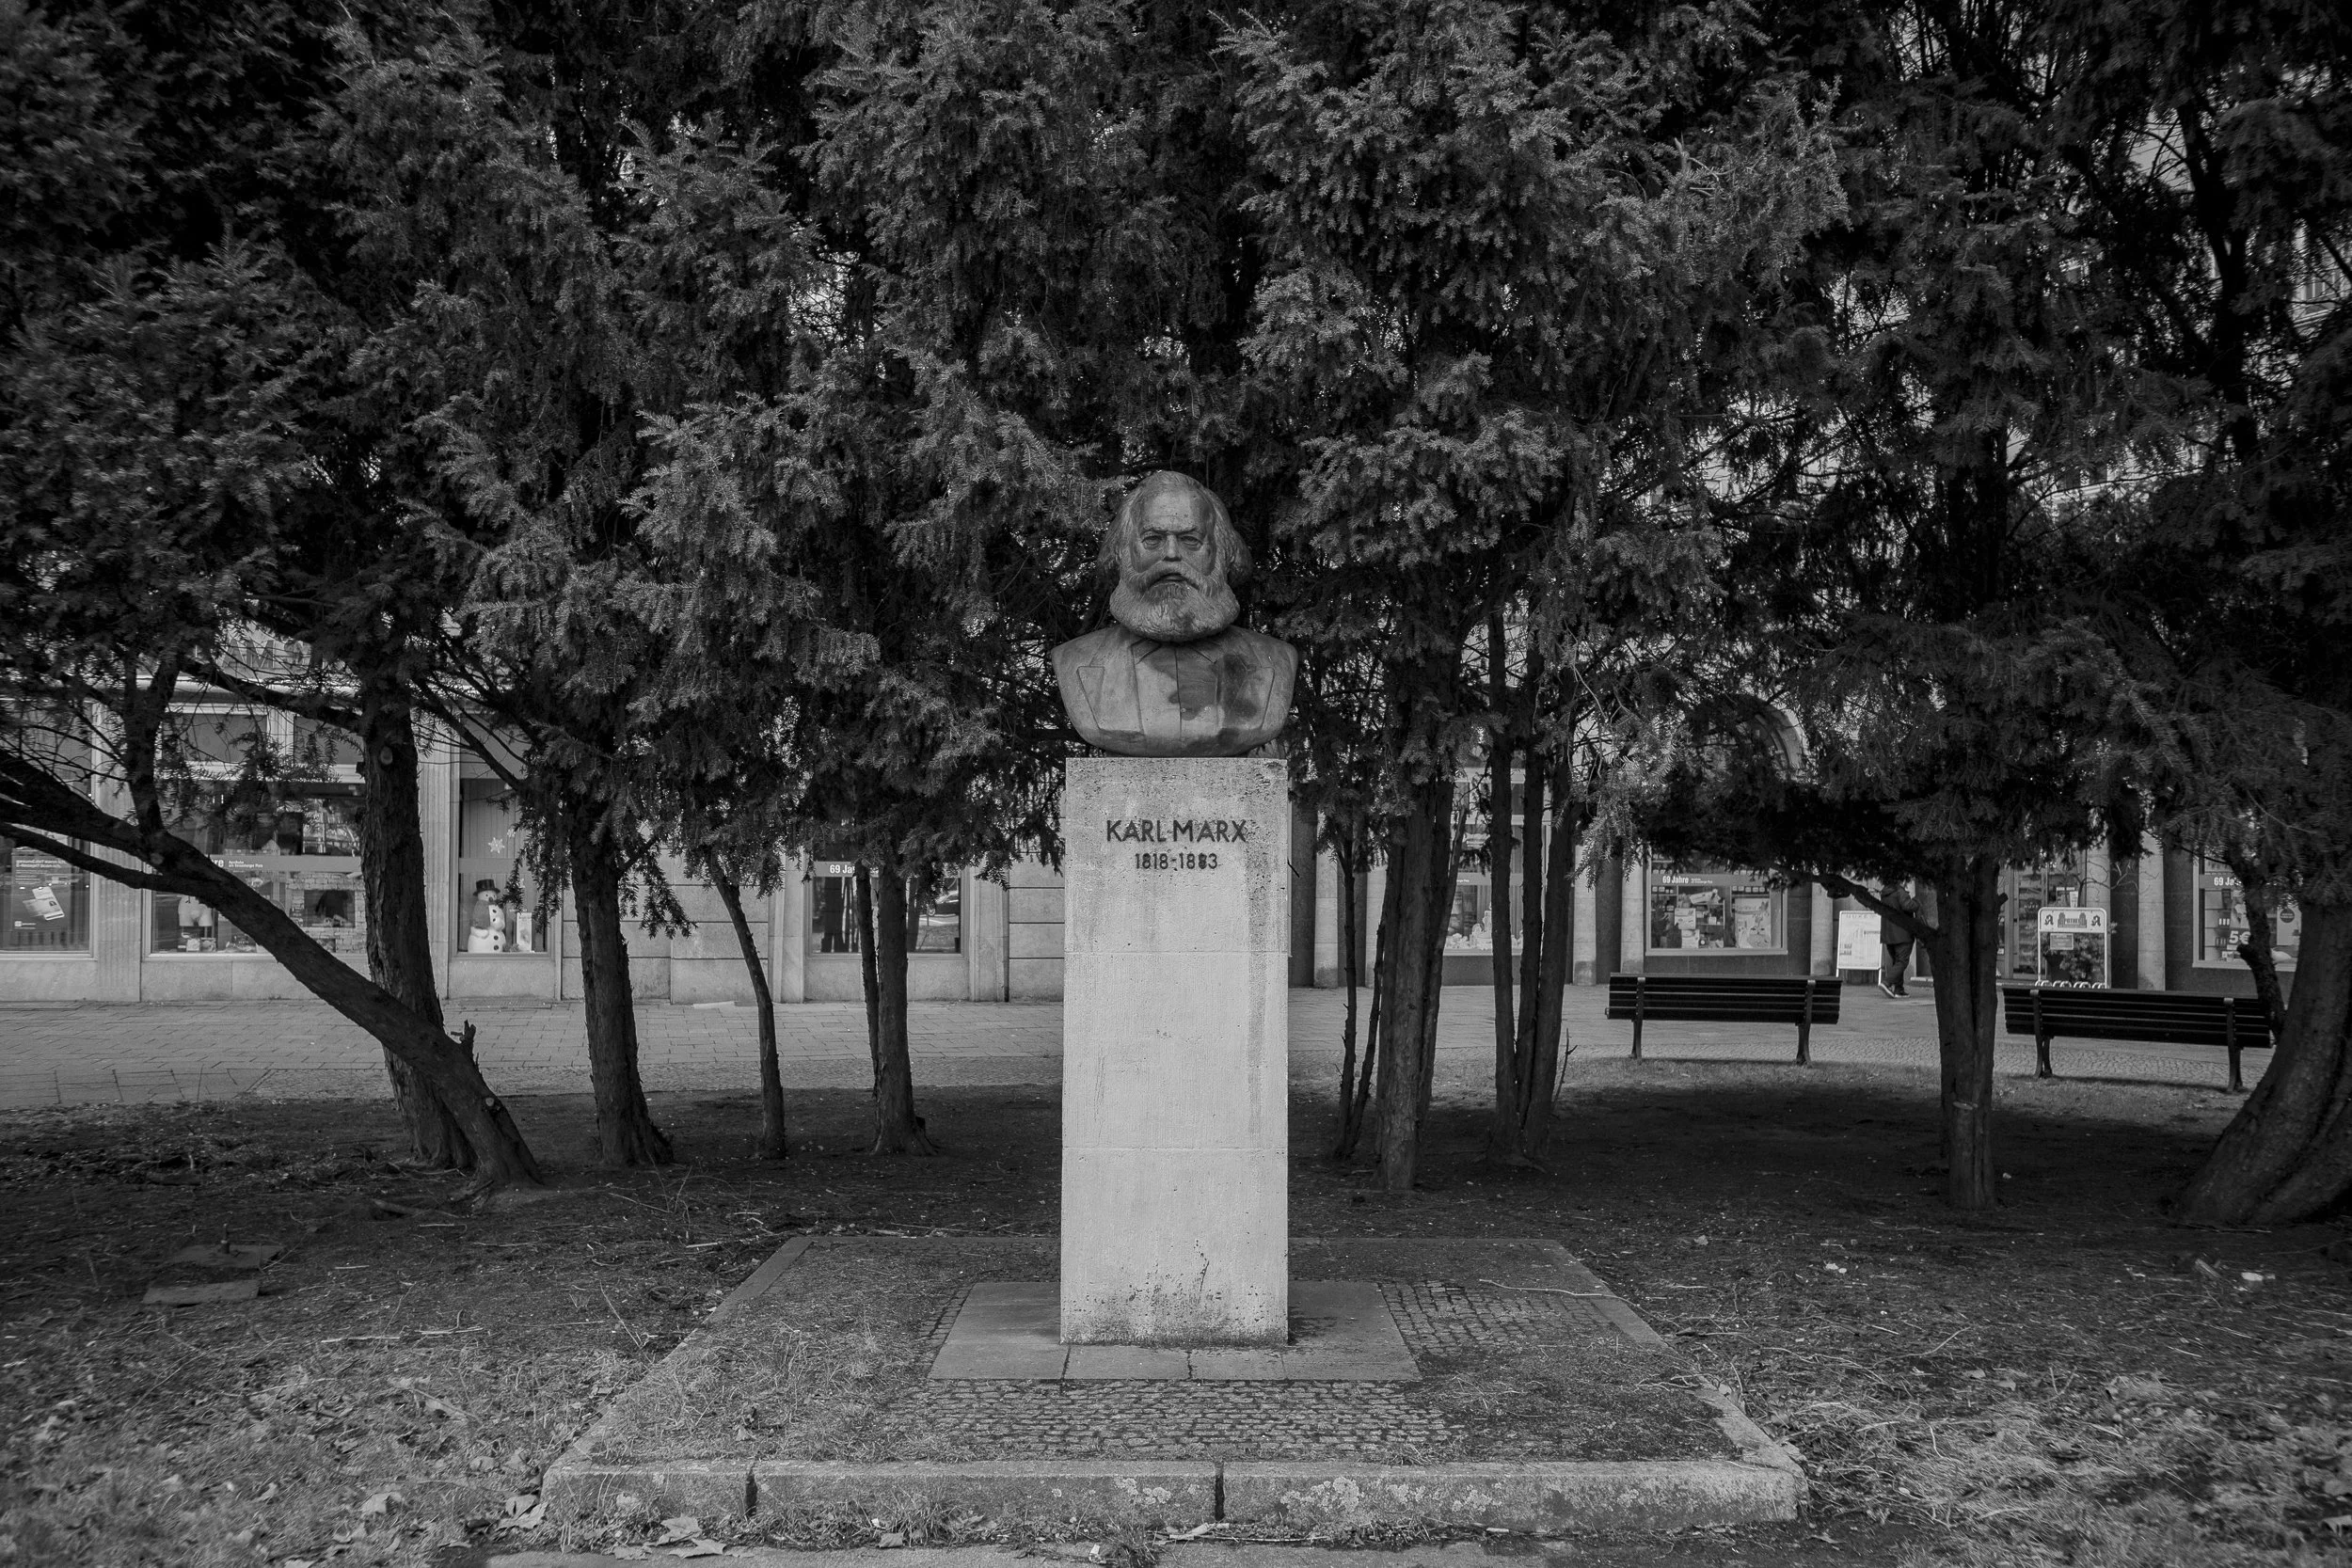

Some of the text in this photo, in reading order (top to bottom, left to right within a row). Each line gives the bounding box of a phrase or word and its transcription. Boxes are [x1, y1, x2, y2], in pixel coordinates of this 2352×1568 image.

[1106, 820, 1247, 842] KARL MARX
[830, 864, 840, 874] 69
[1662, 876, 1671, 884] 69
[1671, 875, 1690, 884] Jahre
[2214, 877, 2224, 886] 69
[2229, 930, 2251, 945] 5€
